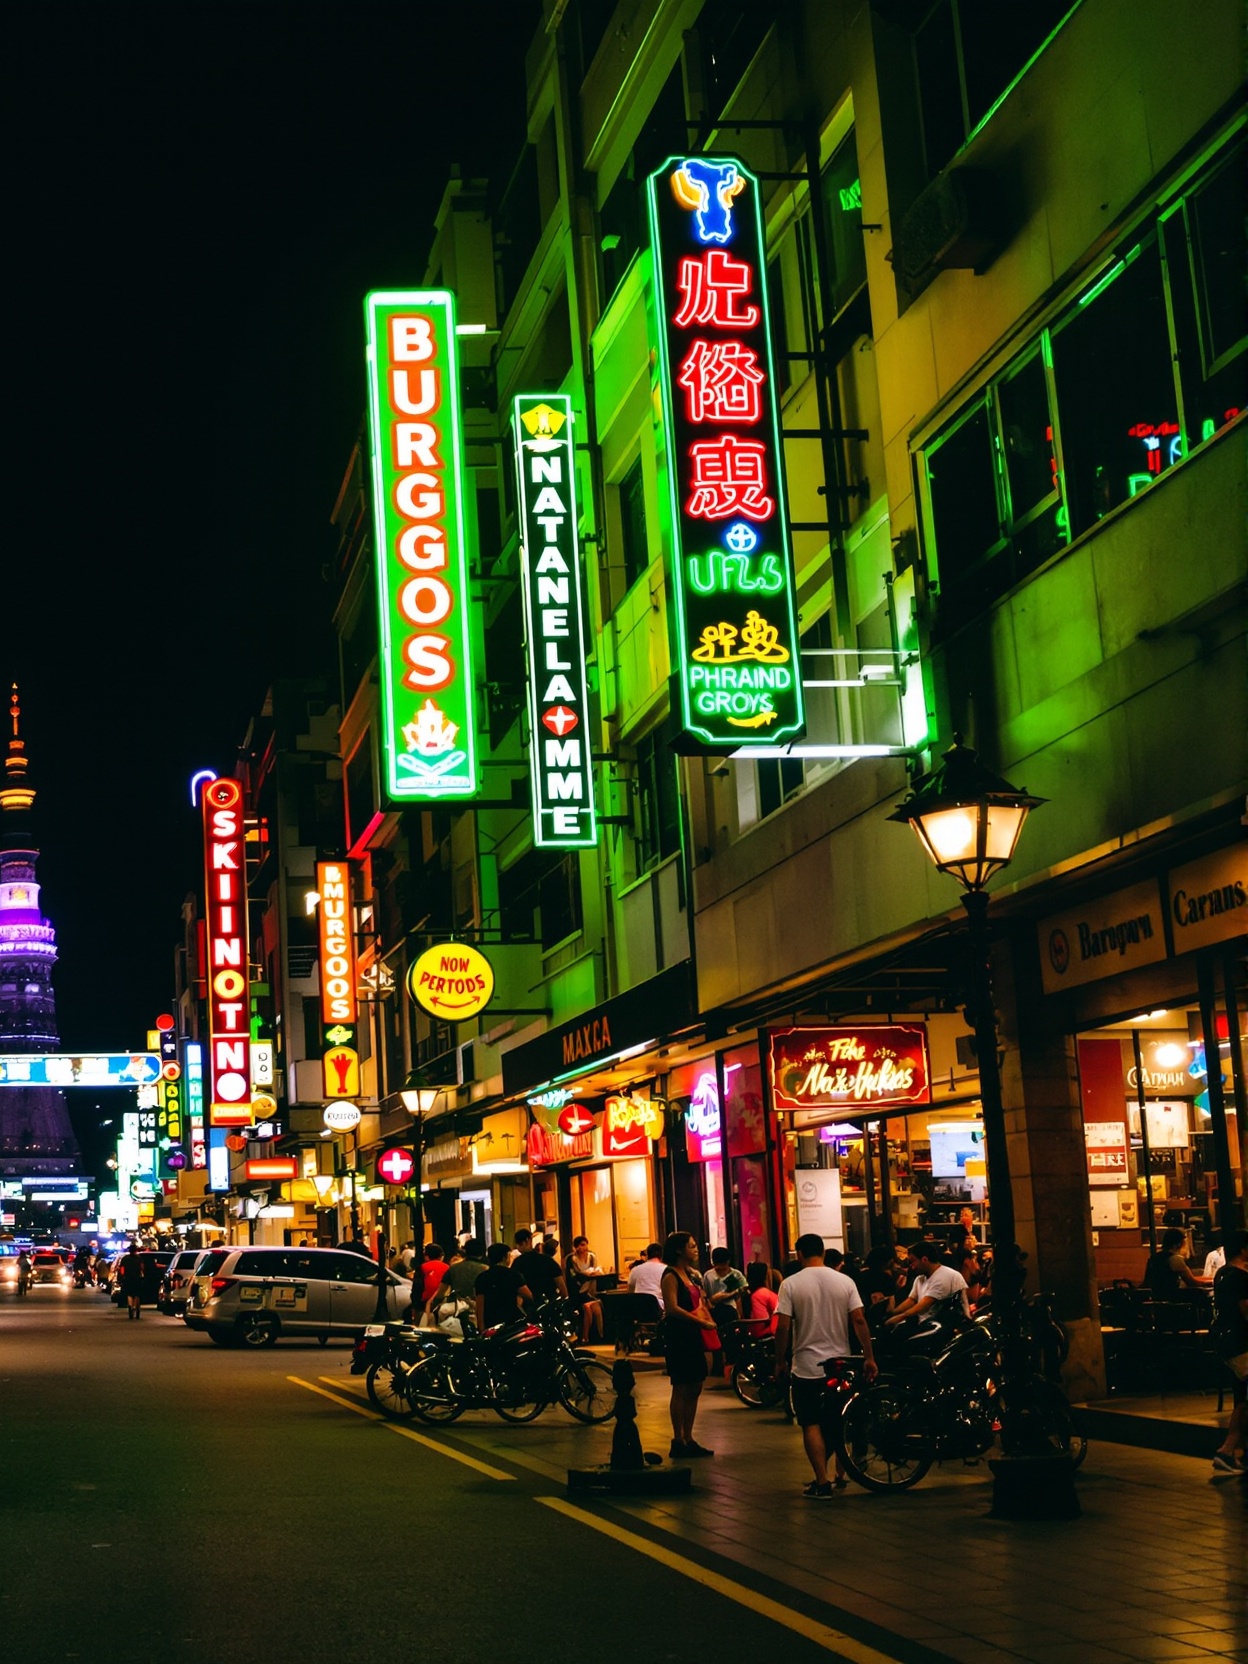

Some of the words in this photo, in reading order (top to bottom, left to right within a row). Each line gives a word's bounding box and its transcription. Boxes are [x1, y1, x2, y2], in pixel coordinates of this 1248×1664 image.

[391, 316, 451, 687] BURGGOS
[530, 456, 577, 702] NATANELA
[691, 666, 791, 689] PHRAIND
[439, 956, 470, 973] NOW
[419, 971, 485, 995] PERTODS
